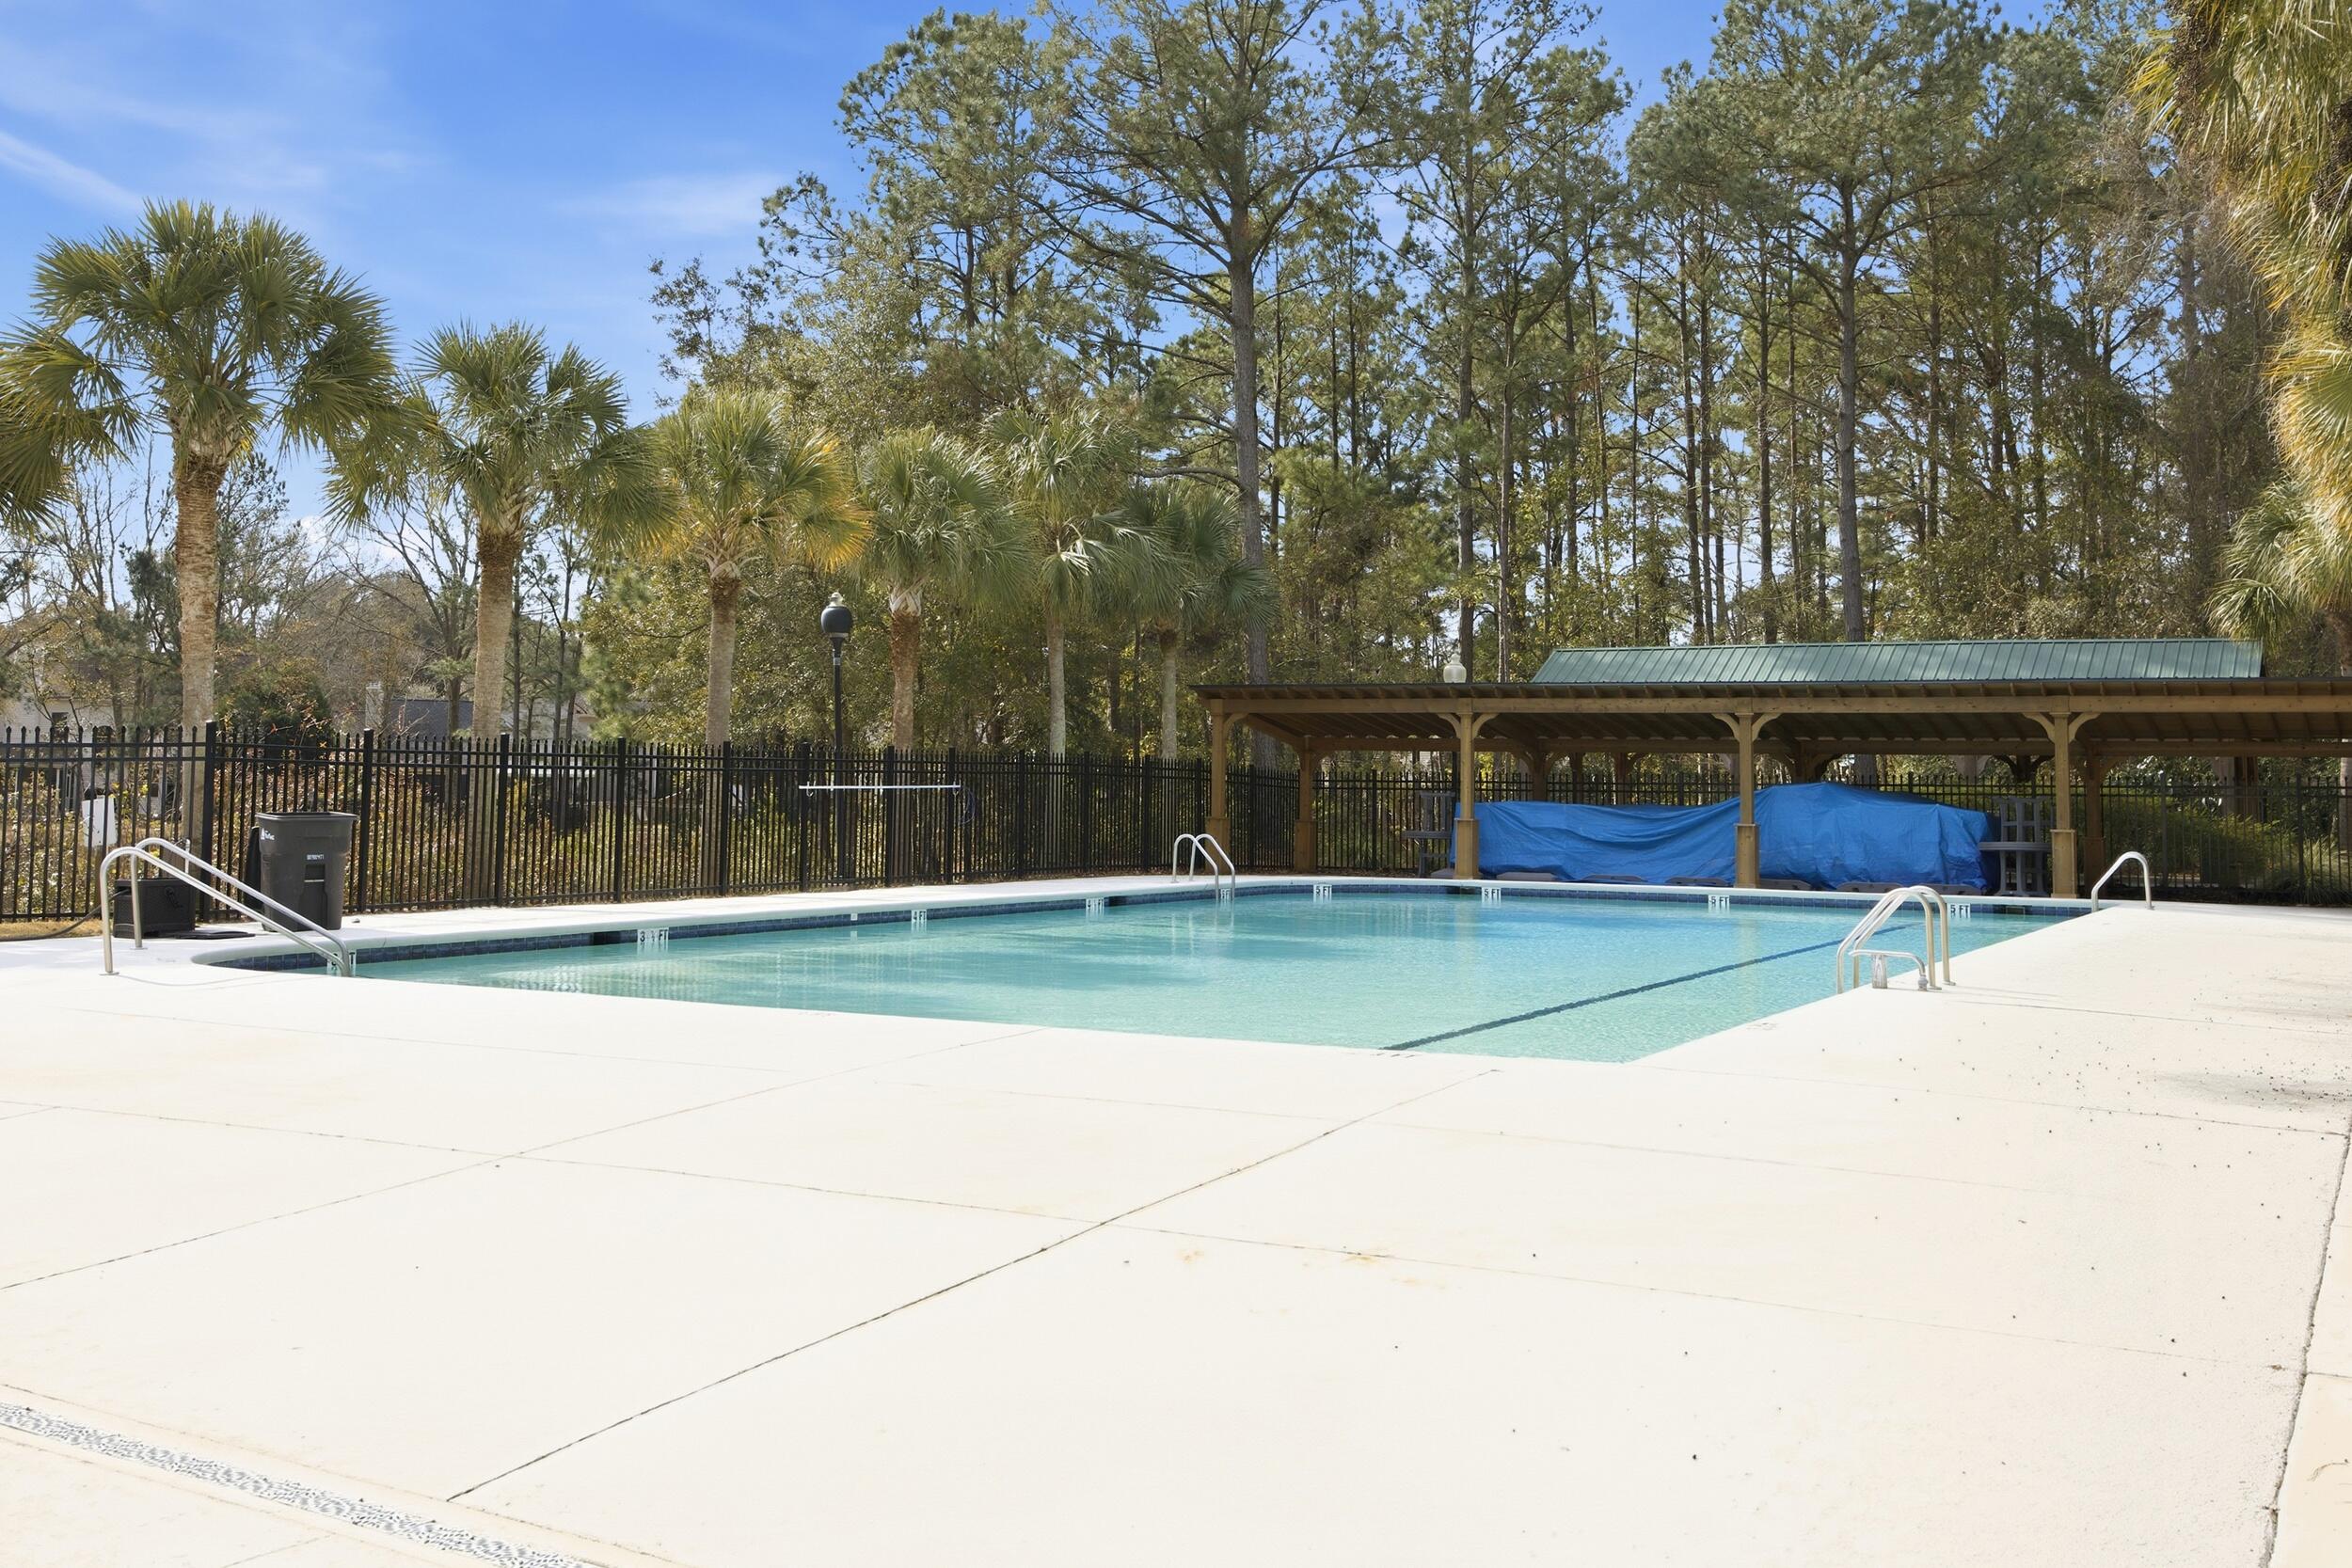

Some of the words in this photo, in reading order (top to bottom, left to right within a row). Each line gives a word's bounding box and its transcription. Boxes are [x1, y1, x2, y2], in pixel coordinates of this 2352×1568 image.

[1316, 885, 1321, 896] 5
[1323, 885, 1330, 896] FT
[1485, 888, 1489, 896] 5
[1492, 888, 1500, 898] FT
[1711, 895, 1716, 907] 5
[1720, 895, 1728, 908] FT
[919, 911, 927, 920] FT
[1950, 904, 1956, 916] 5
[1959, 904, 1969, 917] FT
[640, 931, 645, 942] 3
[659, 928, 668, 941] FT
